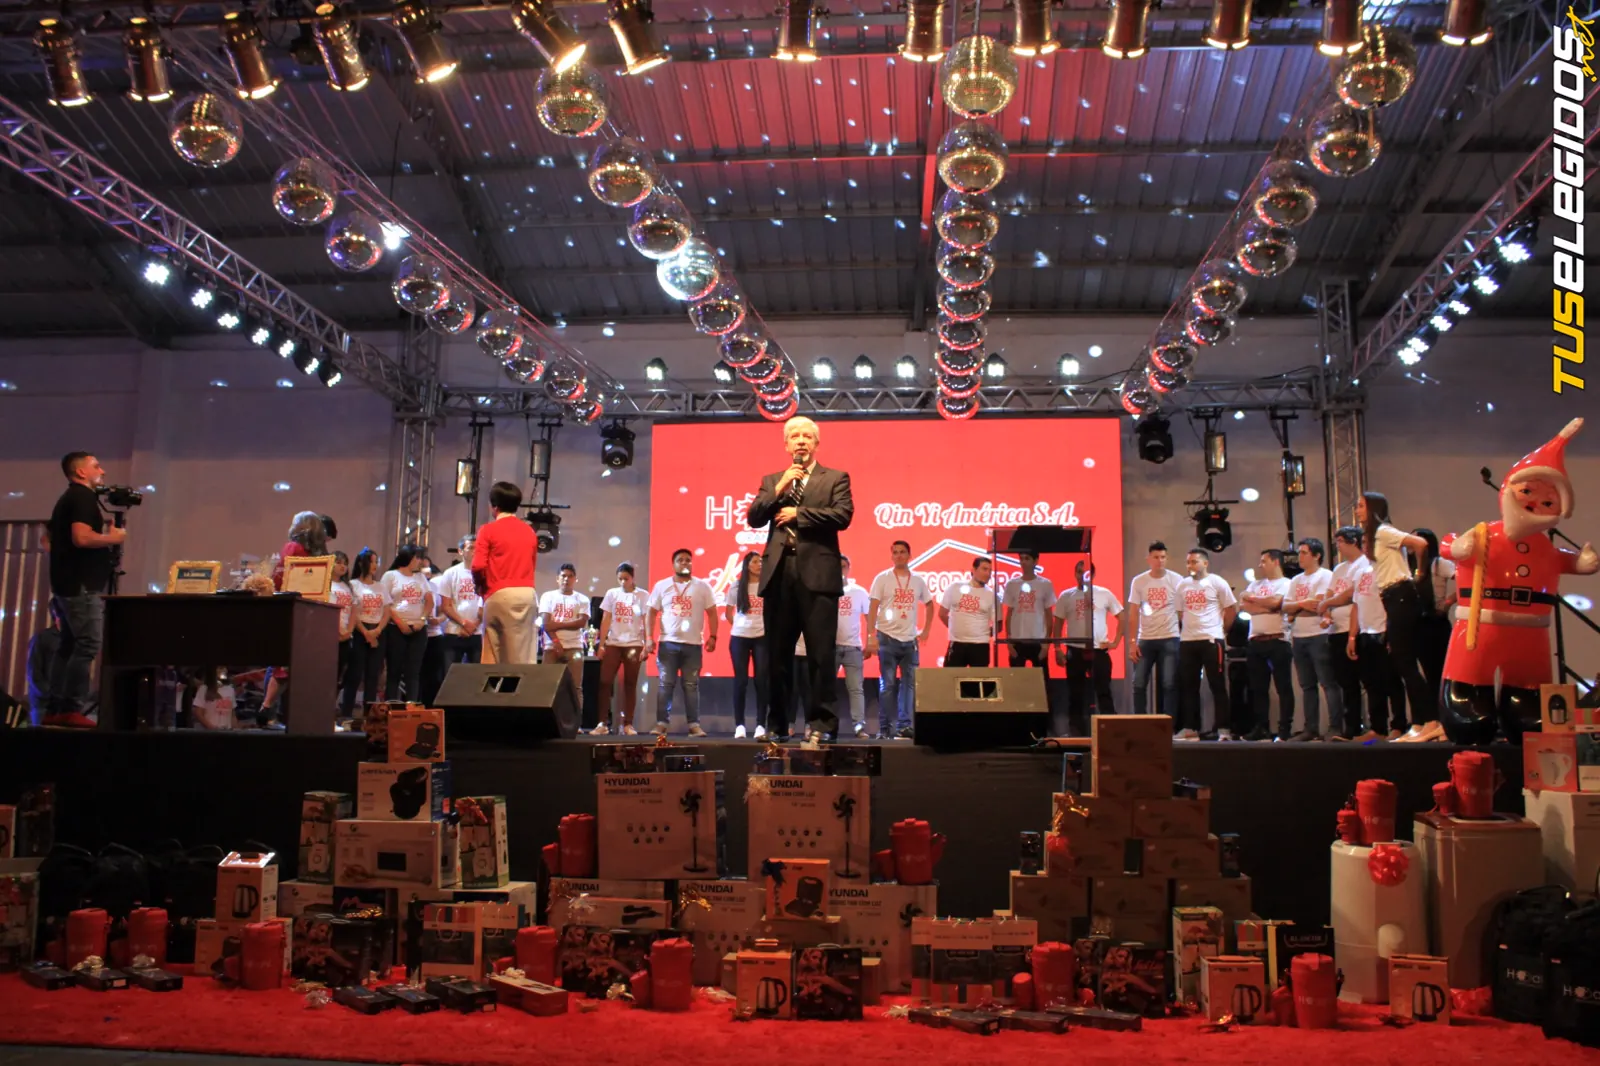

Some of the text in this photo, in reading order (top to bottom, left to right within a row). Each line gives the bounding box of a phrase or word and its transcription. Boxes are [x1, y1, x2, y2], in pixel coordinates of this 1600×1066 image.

[874, 501, 1079, 529] Qin Yi América S.A.
[893, 594, 915, 604] 2020
[1185, 595, 1207, 604] 2020
[604, 777, 650, 786] HYUNDAI
